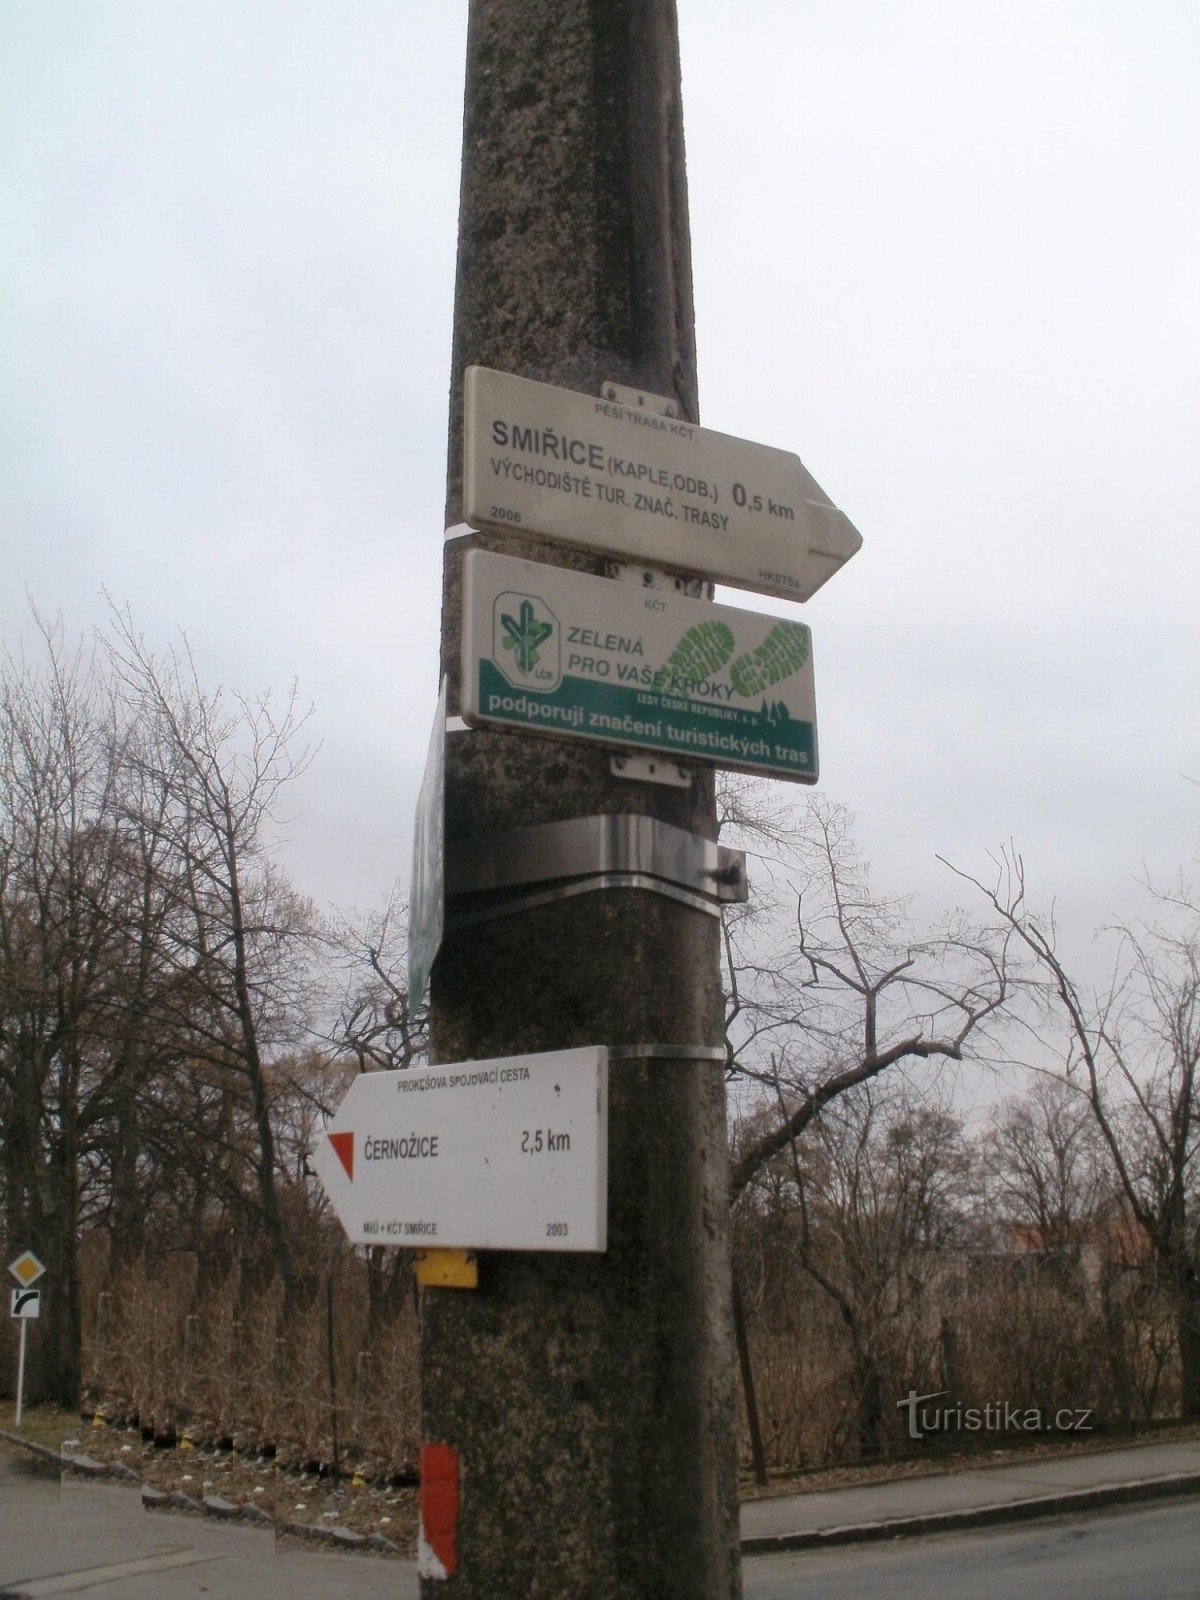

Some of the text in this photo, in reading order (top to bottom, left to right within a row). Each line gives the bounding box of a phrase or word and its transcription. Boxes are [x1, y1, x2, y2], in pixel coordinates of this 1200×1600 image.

[626, 410, 667, 433] TRASA
[670, 421, 695, 440] KČT
[492, 420, 605, 470] SMIŘICE
[732, 483, 763, 512] 0,5
[768, 494, 795, 521] km
[490, 456, 730, 532] VÝCHODIŠTĚ TUR. ZNAČ. TRASY
[490, 506, 522, 523] 2006
[644, 596, 668, 613] KČT
[566, 626, 645, 657] ZELENÁ
[567, 655, 736, 701] PRO VAŠE KROKY
[636, 693, 659, 706] LESY
[660, 695, 689, 712] ČESKÉ
[488, 694, 808, 764] podporují značení turistických tras
[449, 1070, 499, 1087] SPOJOVACÍ
[500, 1067, 530, 1083] CESTA
[364, 1129, 571, 1160] ČERNOŽICE 2,5 km
[386, 1220, 402, 1234] KČT
[404, 1219, 438, 1235] SMIŘICE
[546, 1223, 569, 1237] 2003
